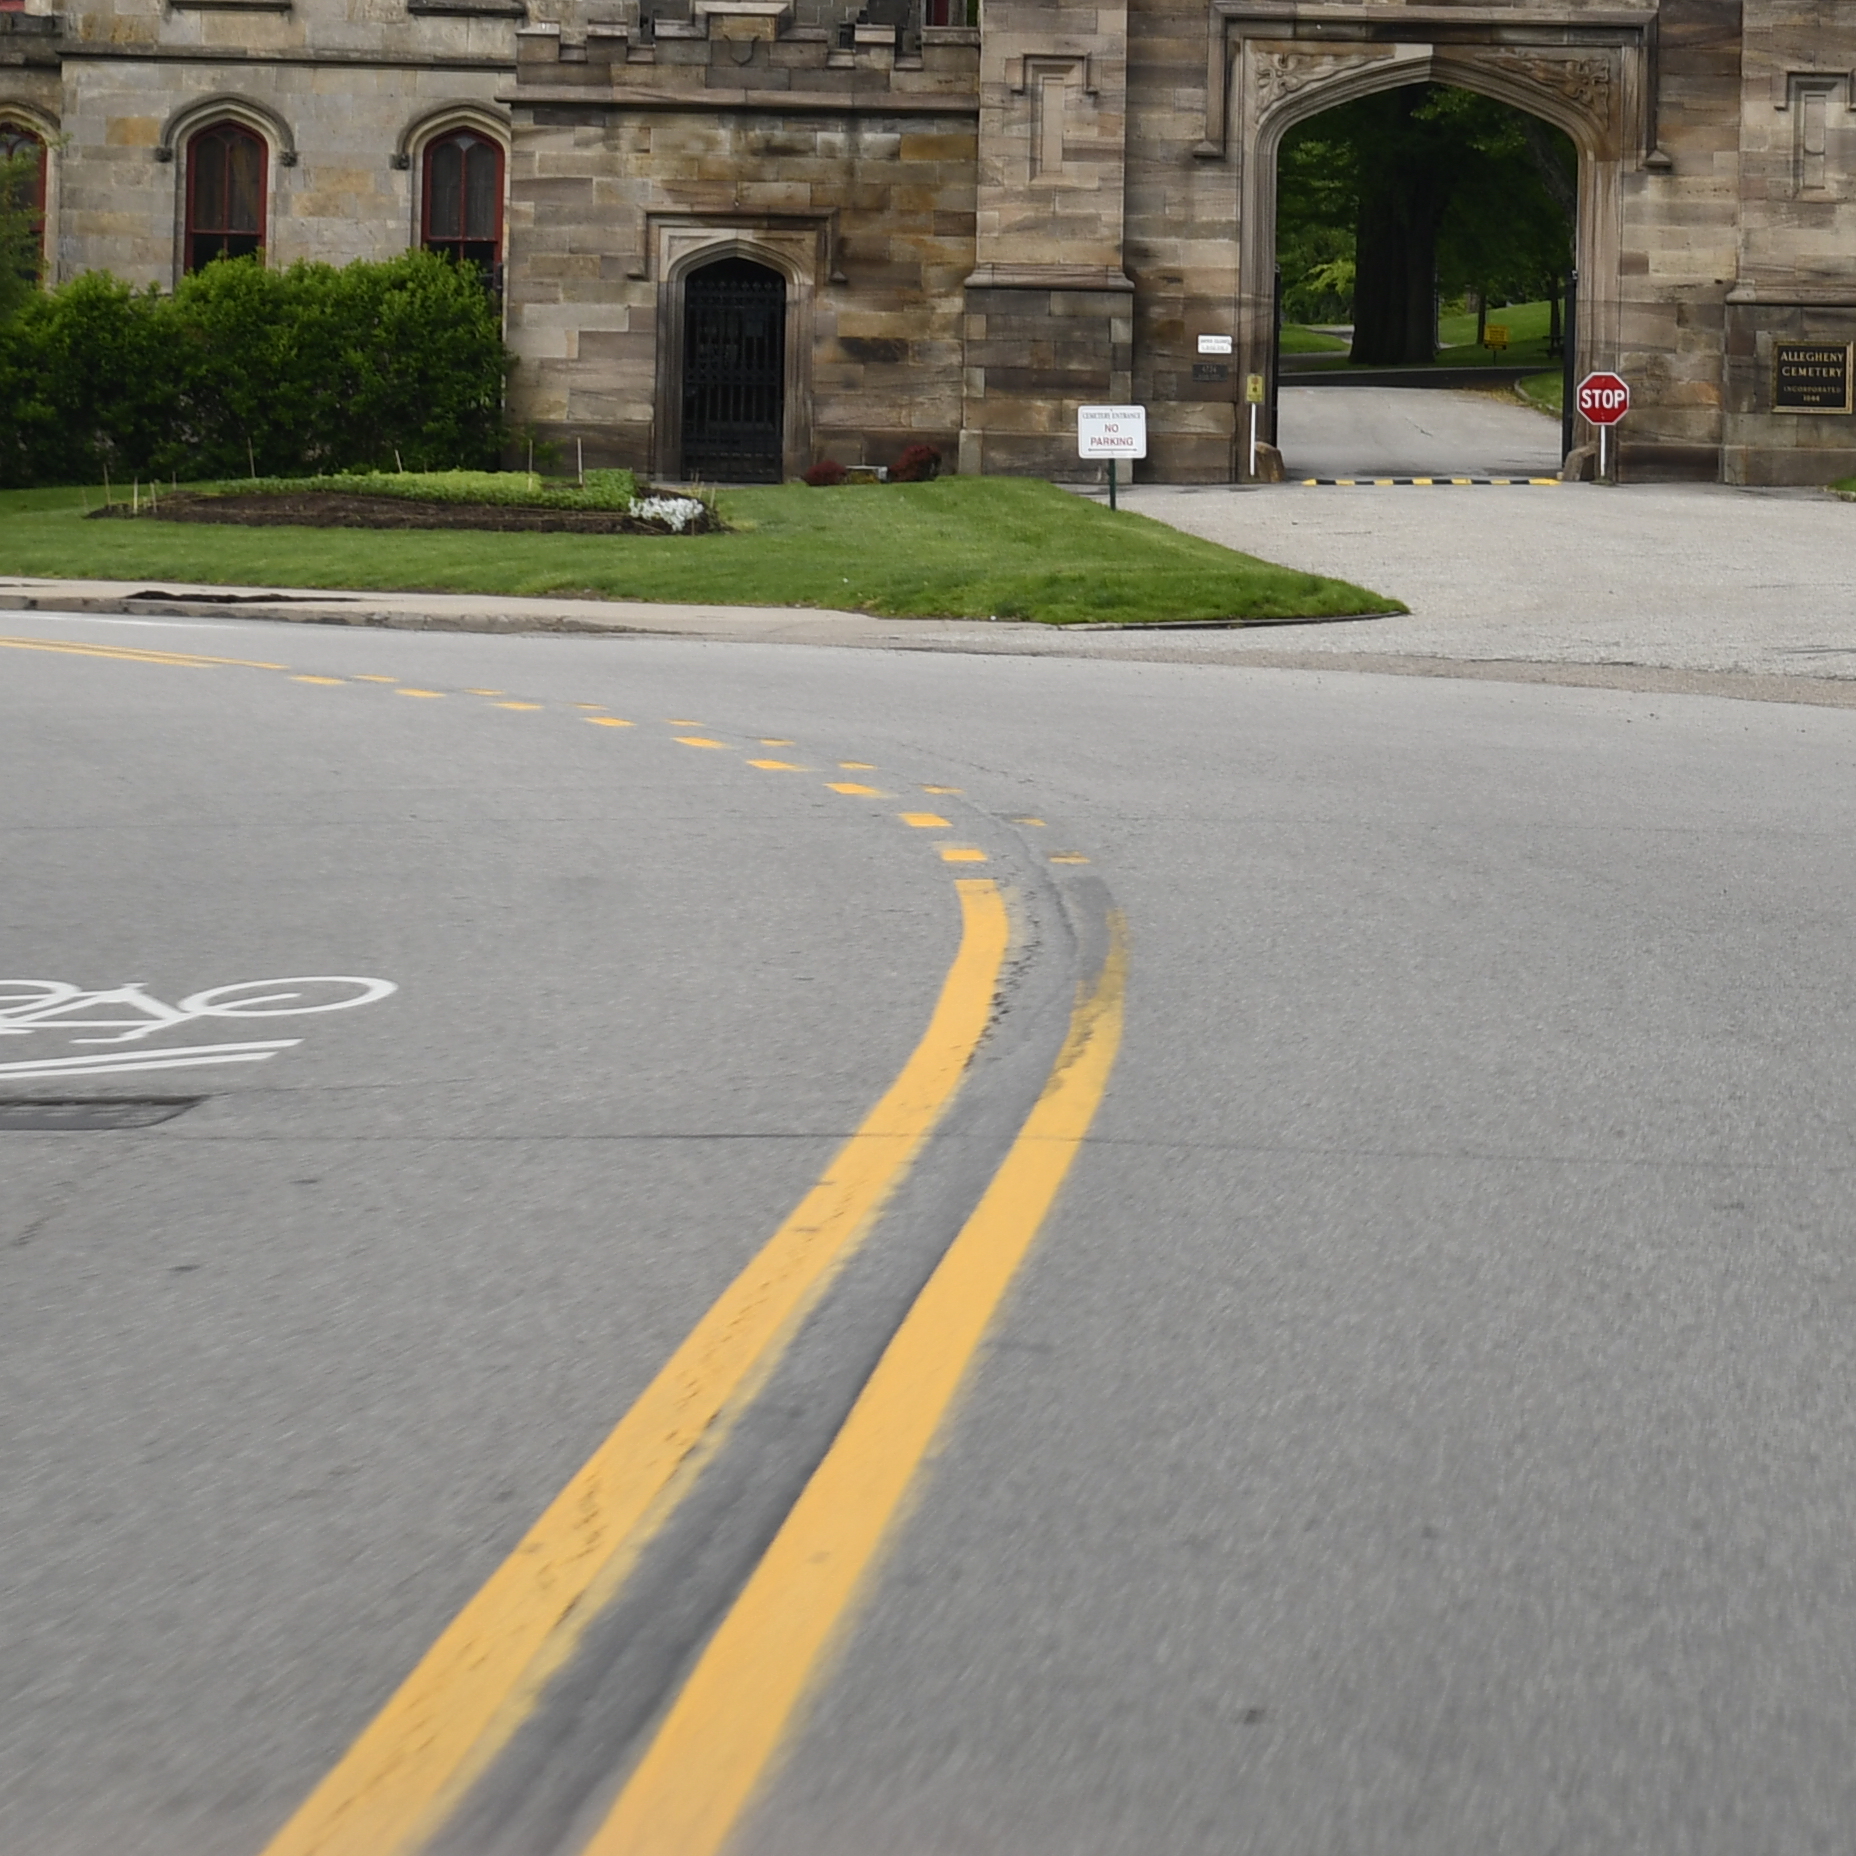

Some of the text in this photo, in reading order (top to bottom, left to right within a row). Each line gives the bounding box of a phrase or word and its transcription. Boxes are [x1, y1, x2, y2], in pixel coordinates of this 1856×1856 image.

[1780, 351, 1844, 362] ALLEGHENY
[1781, 366, 1843, 377] CEMETERY
[1784, 385, 1841, 394] INCORPORATED
[1581, 389, 1625, 409] STOP
[1104, 423, 1119, 433] NO
[1090, 436, 1134, 446] PARKING
